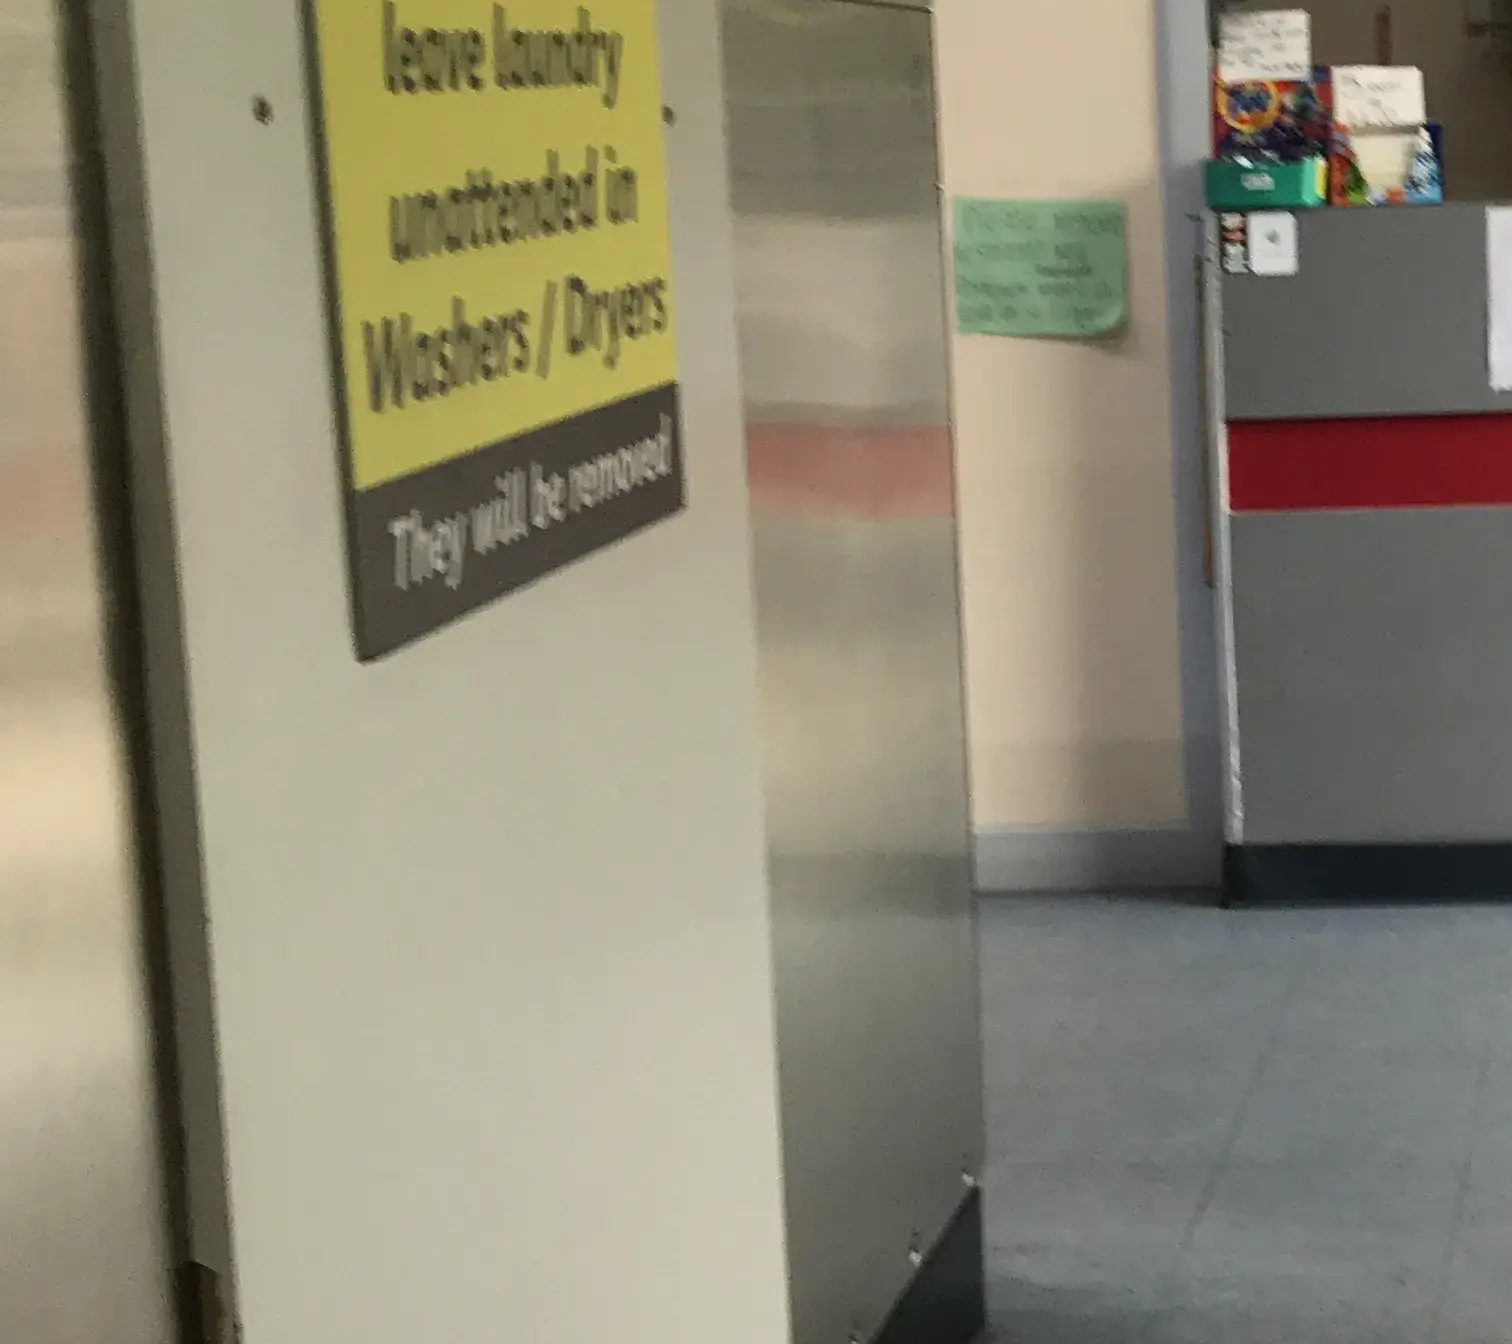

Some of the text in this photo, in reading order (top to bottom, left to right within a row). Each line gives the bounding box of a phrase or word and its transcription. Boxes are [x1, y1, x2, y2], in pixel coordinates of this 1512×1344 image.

[381, 0, 625, 108] leave laundry
[388, 146, 640, 264] unattended in
[362, 274, 669, 414] Washers / Dryers
[386, 414, 673, 590] They will be removed
